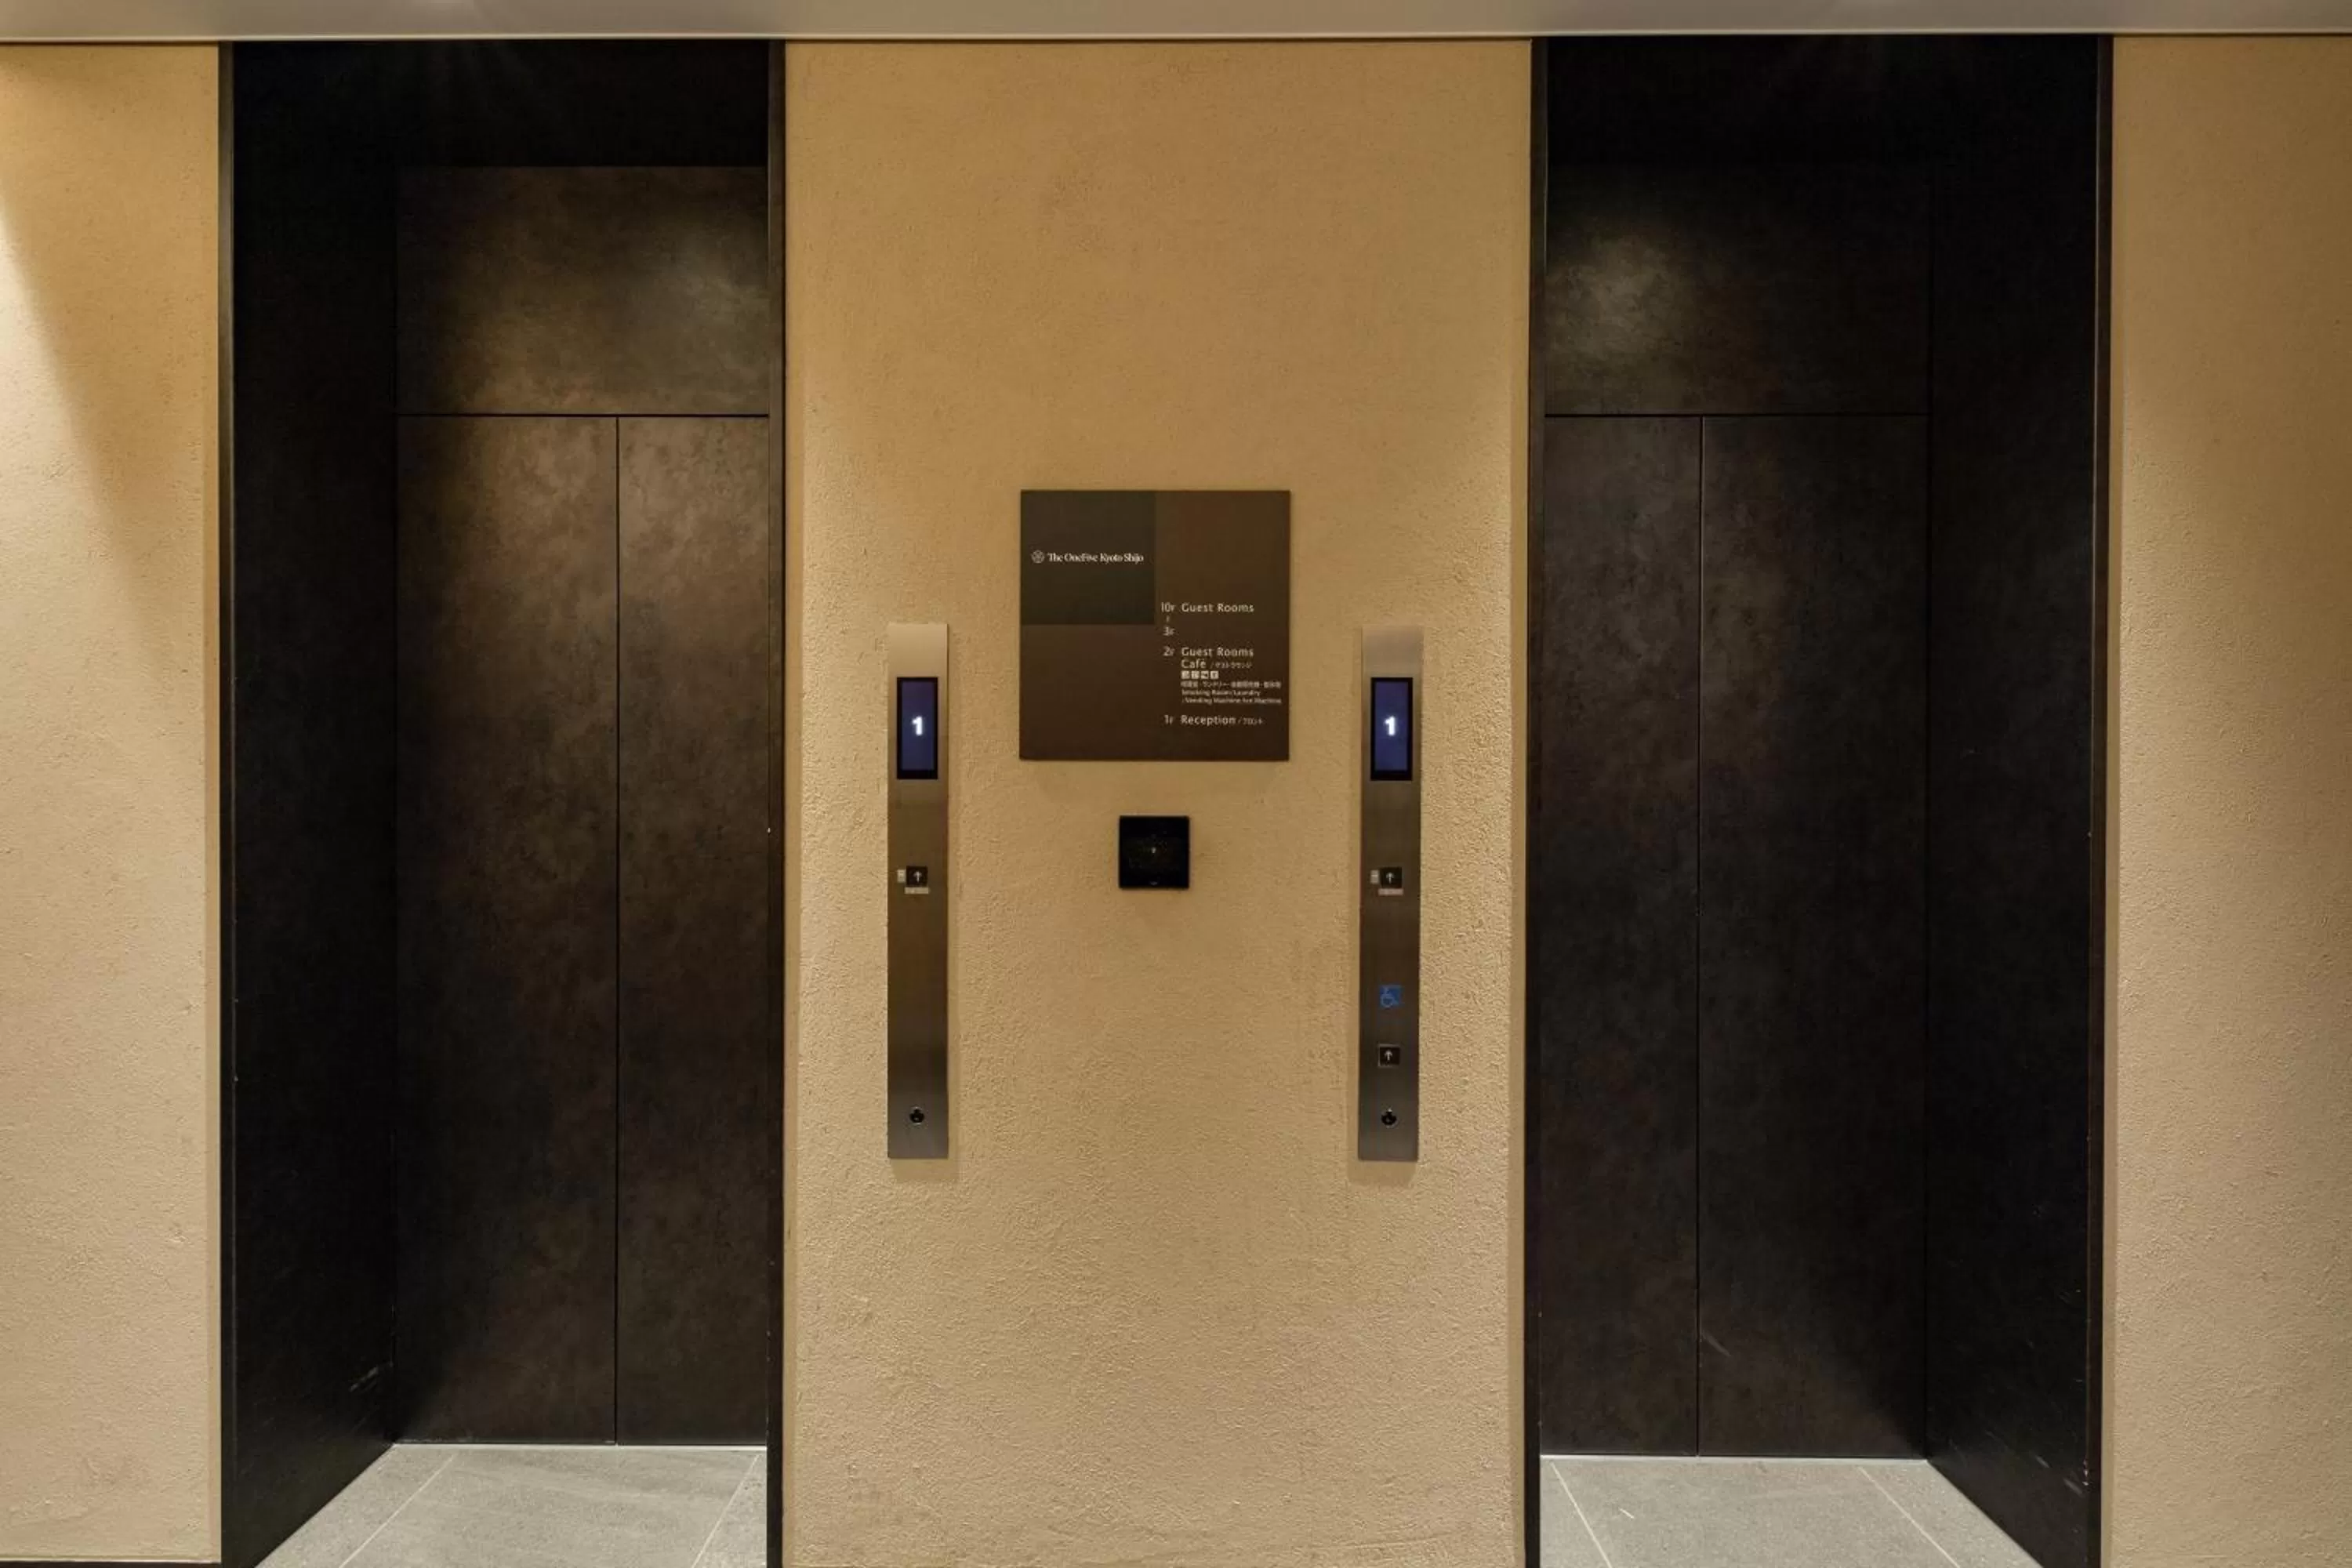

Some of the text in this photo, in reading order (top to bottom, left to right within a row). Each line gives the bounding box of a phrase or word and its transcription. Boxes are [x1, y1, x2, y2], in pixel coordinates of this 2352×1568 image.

[1047, 552, 1144, 564] The OneFive Kyoto Shijo
[1181, 602, 1214, 612] Guest
[1217, 602, 1254, 612] Rooms
[1181, 647, 1214, 657] Guest
[1217, 647, 1254, 657] Rooms
[1181, 658, 1207, 669] Café
[912, 716, 923, 736] 1
[1180, 714, 1236, 727] Reception
[1385, 716, 1396, 736] 1
